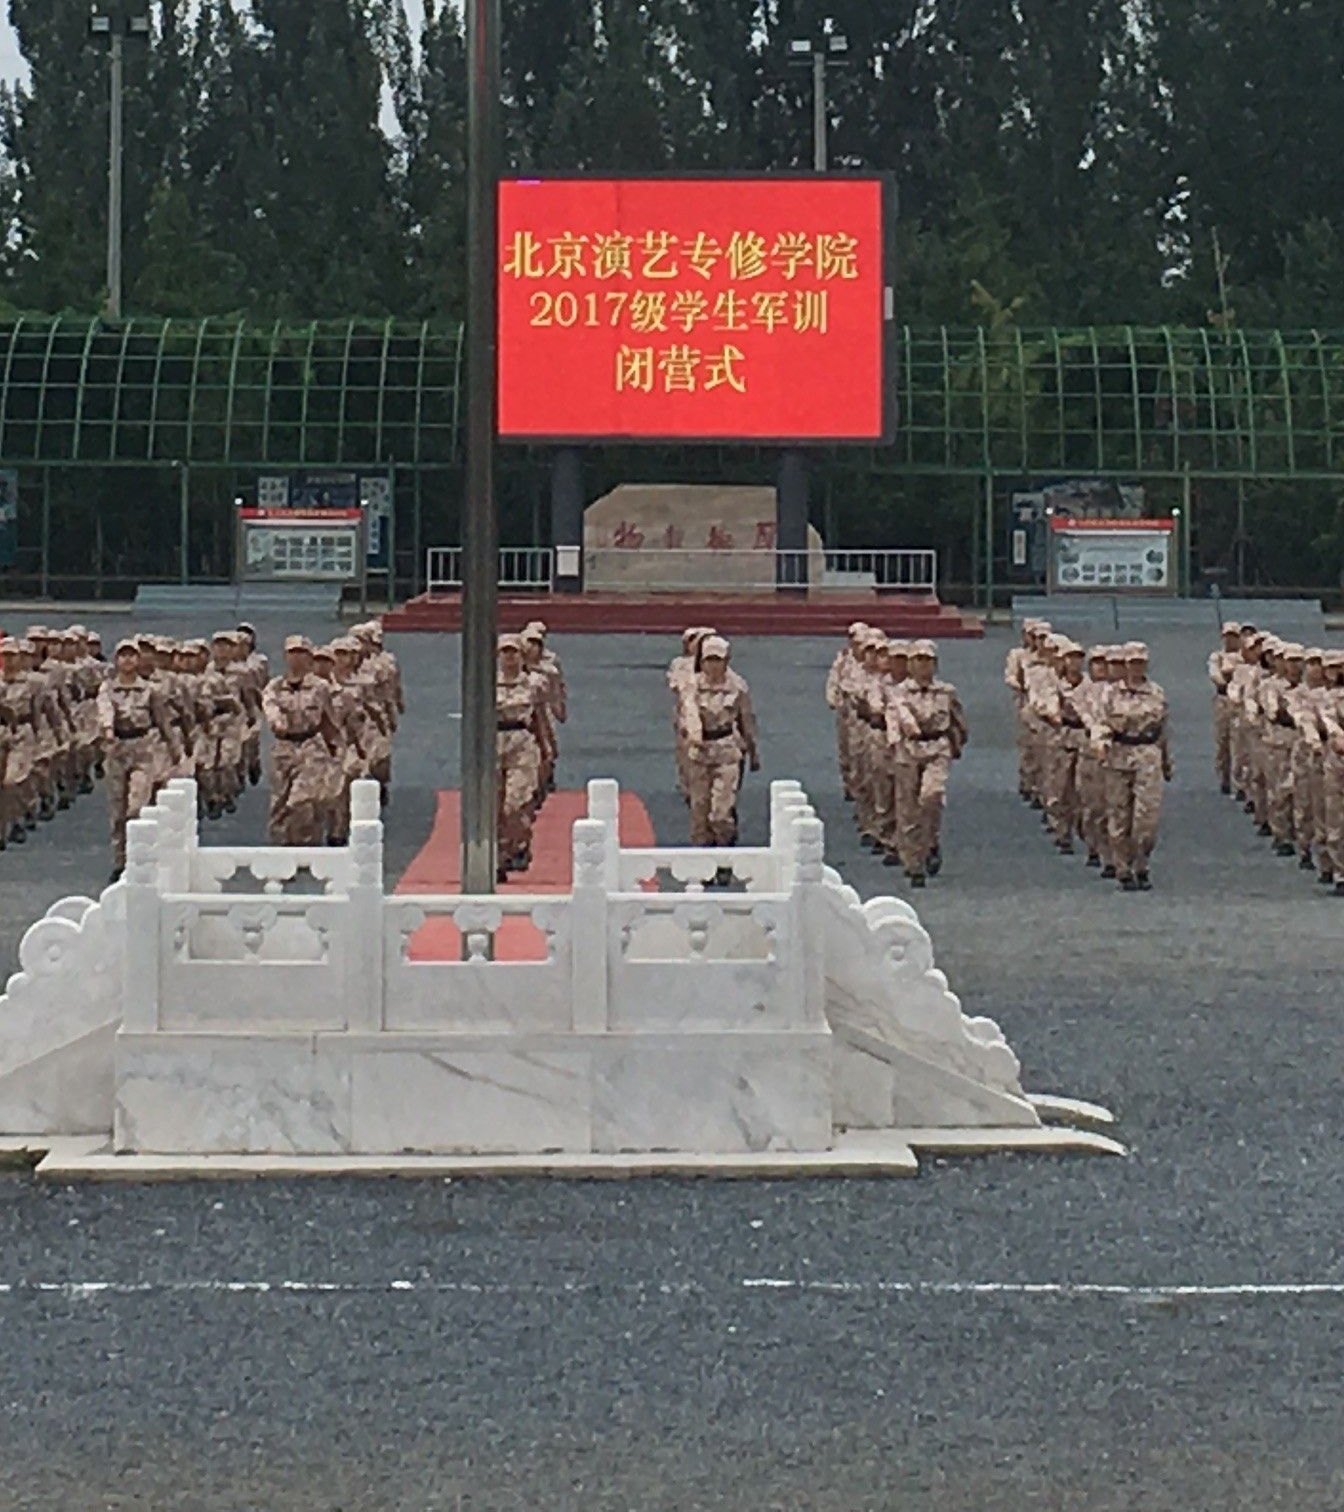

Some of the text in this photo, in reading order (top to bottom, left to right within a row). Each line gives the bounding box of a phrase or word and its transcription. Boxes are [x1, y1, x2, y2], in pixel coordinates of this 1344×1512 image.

[503, 229, 859, 280] 北京演艺专修学院
[529, 288, 828, 334] 2017级学生军训
[615, 343, 747, 394] 闭营式
